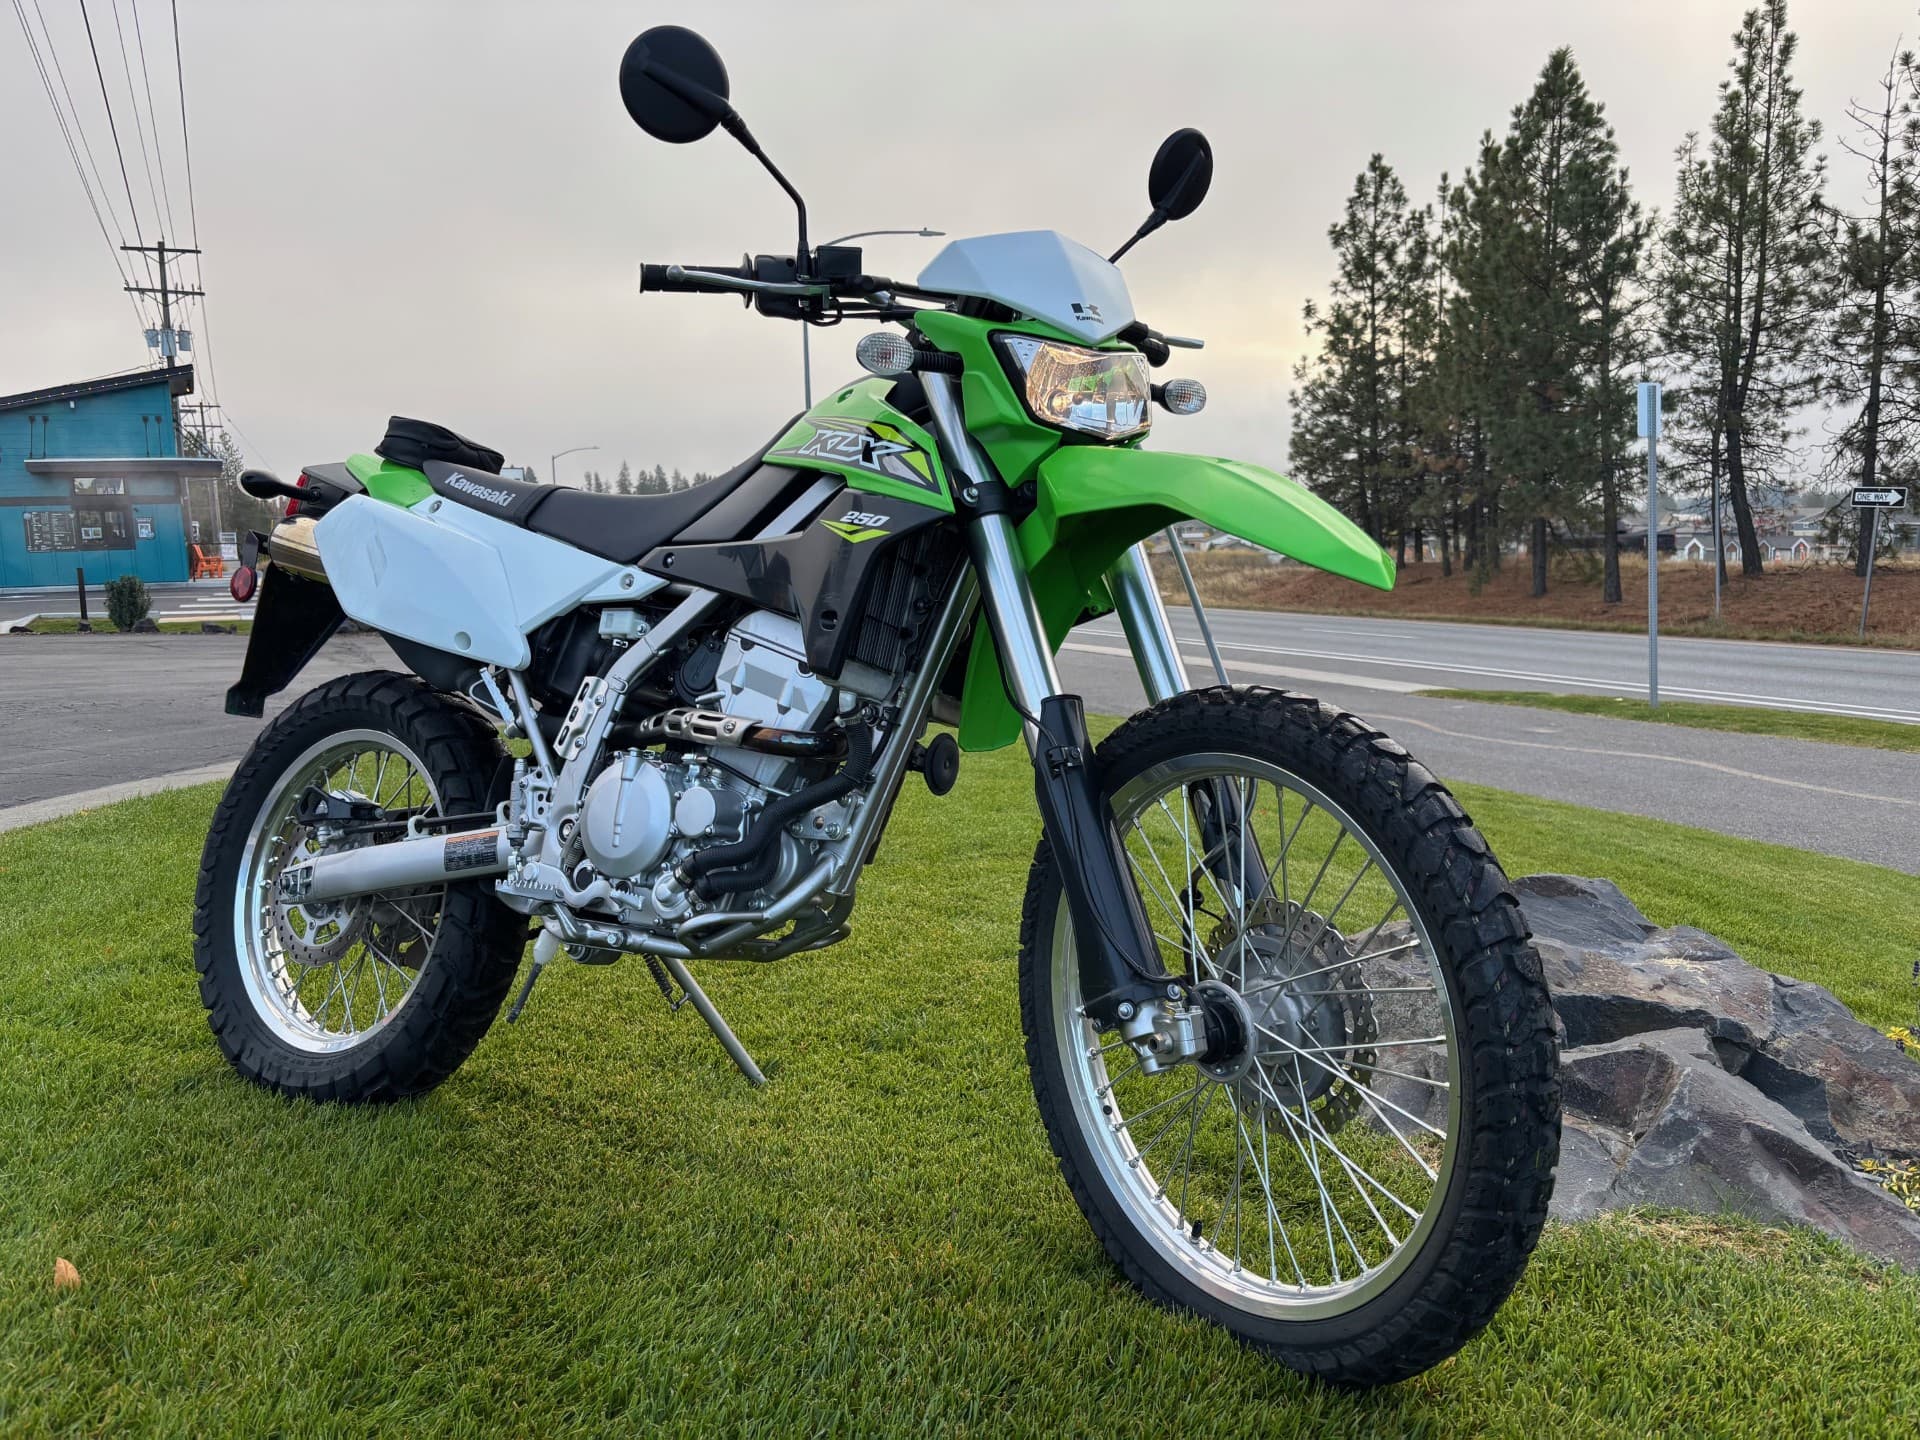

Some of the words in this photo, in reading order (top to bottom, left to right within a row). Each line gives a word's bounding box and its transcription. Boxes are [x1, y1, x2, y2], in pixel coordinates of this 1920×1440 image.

[798, 430, 912, 471] KLX
[444, 472, 517, 507] Kawasaki
[1856, 493, 1872, 501] ONE
[1874, 493, 1890, 501] WAY
[839, 511, 890, 527] 250
